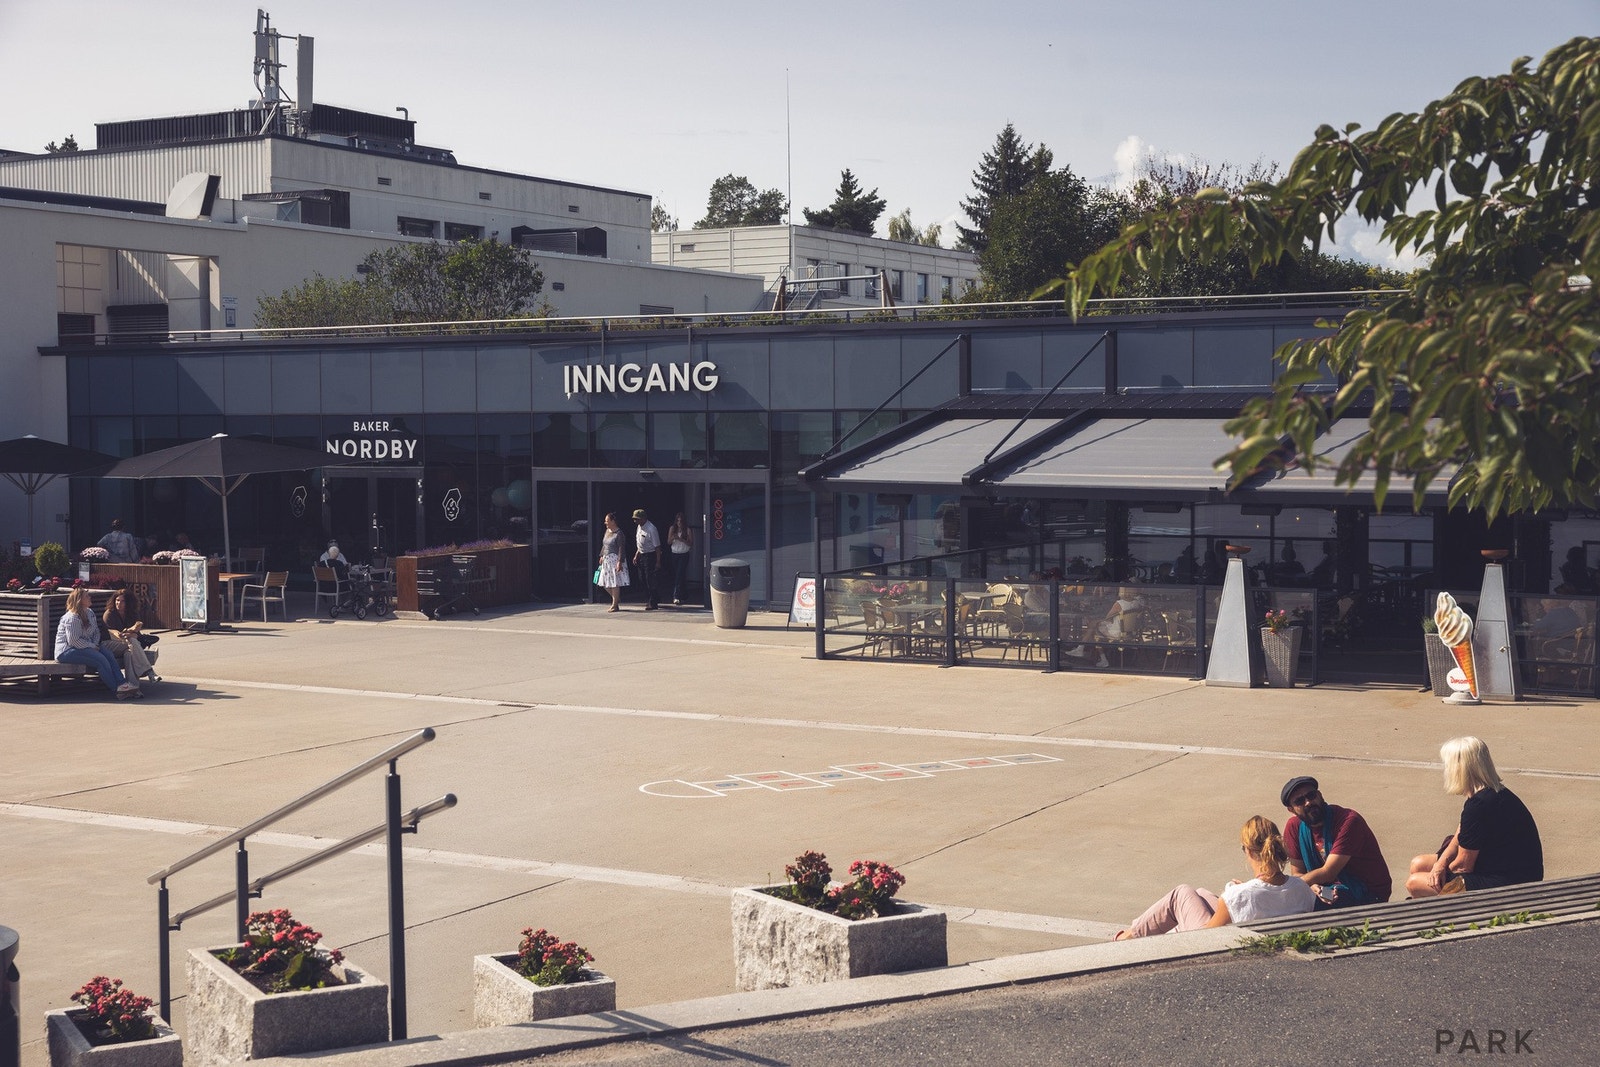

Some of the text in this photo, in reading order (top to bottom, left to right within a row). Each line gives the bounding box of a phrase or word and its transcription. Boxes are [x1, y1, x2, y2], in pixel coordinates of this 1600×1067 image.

[564, 361, 719, 394] INNGANG
[353, 421, 389, 432] BAKER
[326, 439, 417, 459] NORDBY
